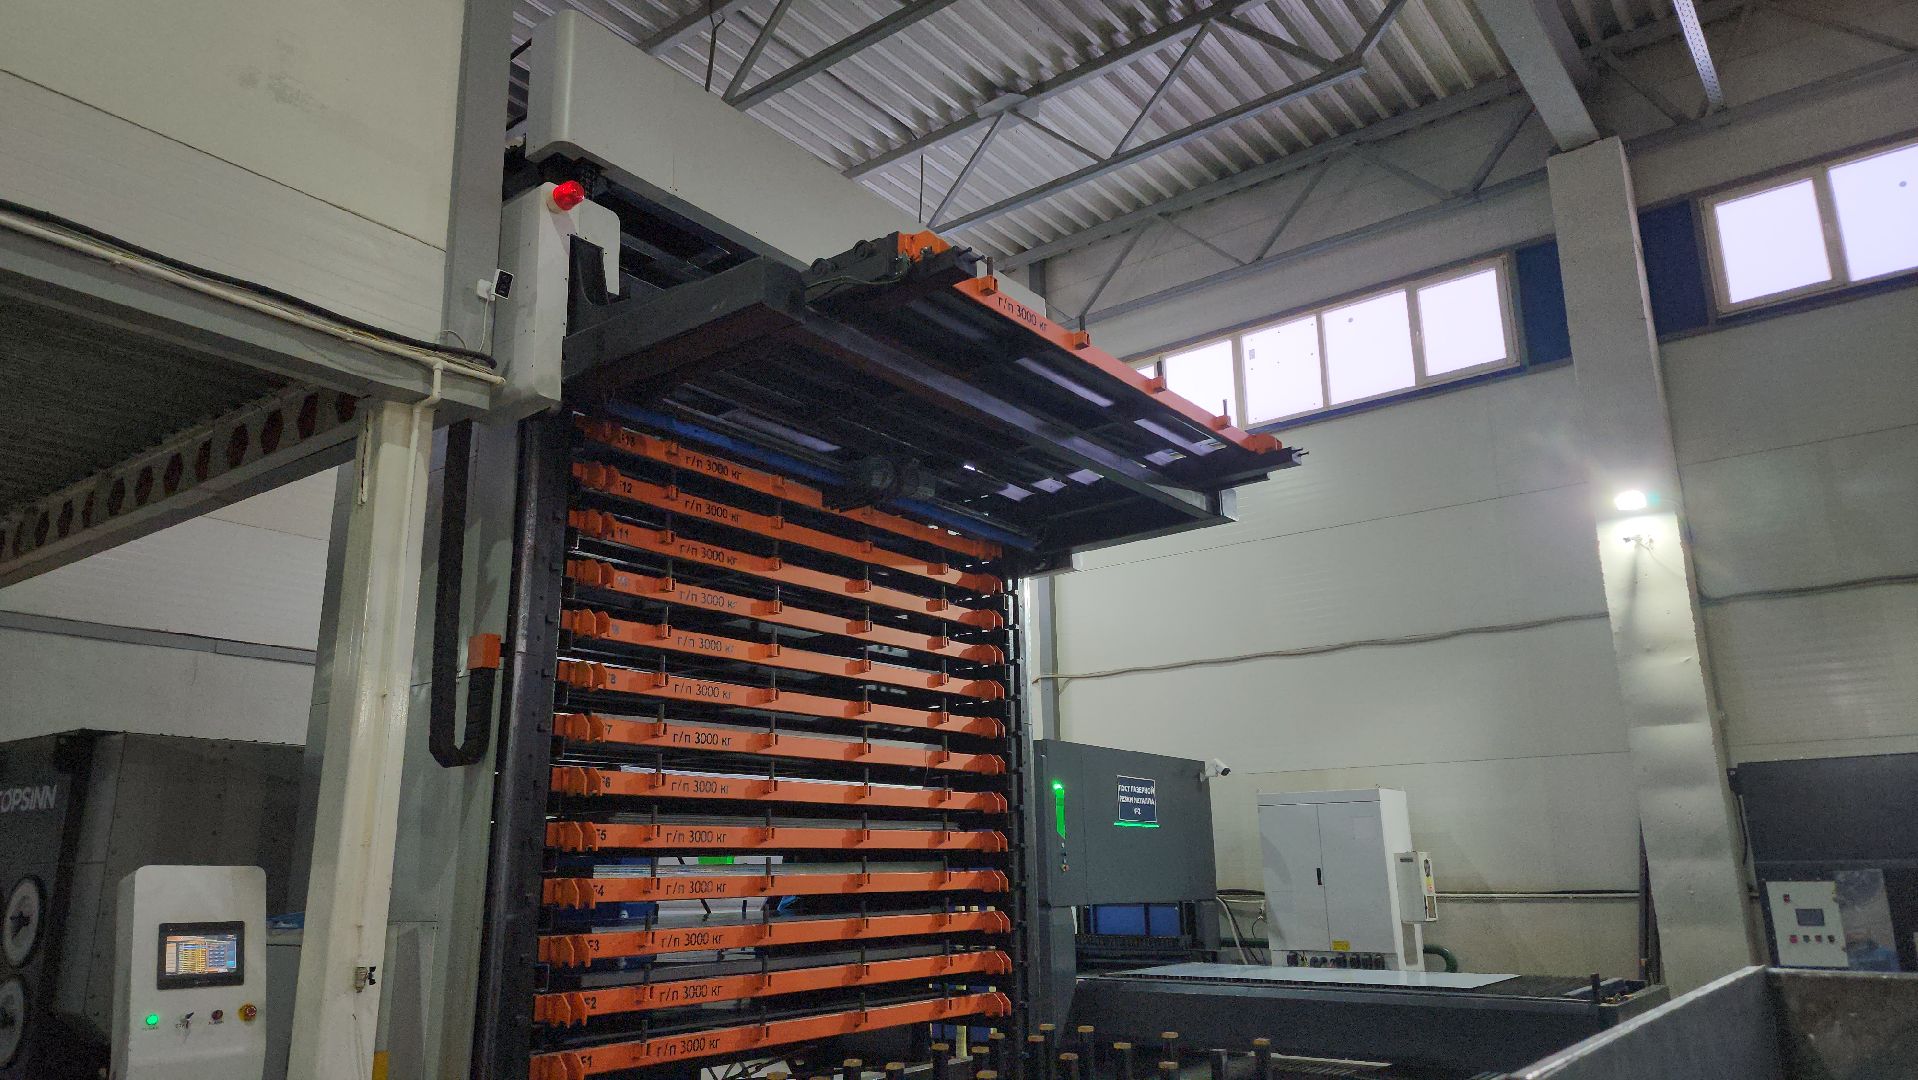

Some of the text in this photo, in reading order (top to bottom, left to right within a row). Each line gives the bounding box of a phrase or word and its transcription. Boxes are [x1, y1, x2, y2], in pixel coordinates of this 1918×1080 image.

[1017, 304, 1037, 326] 3000
[707, 460, 729, 476] 3000
[706, 502, 728, 519] 3000
[701, 547, 725, 562] 3000
[701, 592, 725, 607] 3000
[699, 638, 722, 652] 3000
[696, 685, 720, 698] 3000
[694, 732, 719, 746] 3000
[693, 780, 718, 794] 3000
[0, 785, 57, 813] OPSINN
[689, 830, 714, 843] 3000
[689, 880, 713, 894] 3000
[684, 932, 709, 946] 3000
[682, 984, 708, 1000] 3000
[680, 1038, 706, 1053] 3000
